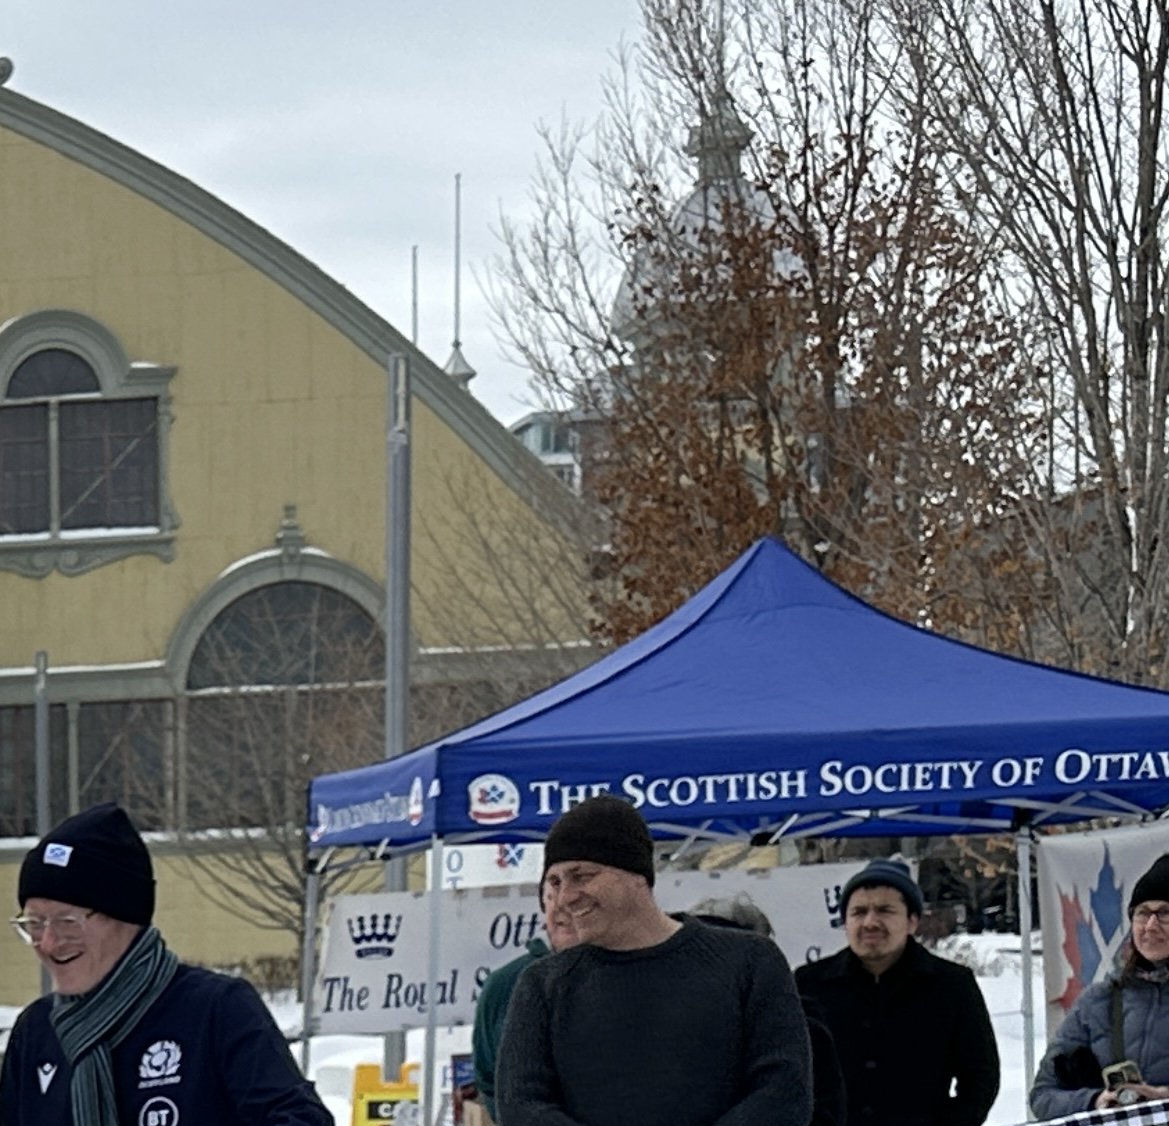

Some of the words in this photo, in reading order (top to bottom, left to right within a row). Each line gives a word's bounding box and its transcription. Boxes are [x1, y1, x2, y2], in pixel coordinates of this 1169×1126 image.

[622, 769, 808, 809] SCOTTISH
[819, 760, 983, 796] SOCIETY
[990, 757, 1044, 787] OF
[322, 975, 370, 1014] The
